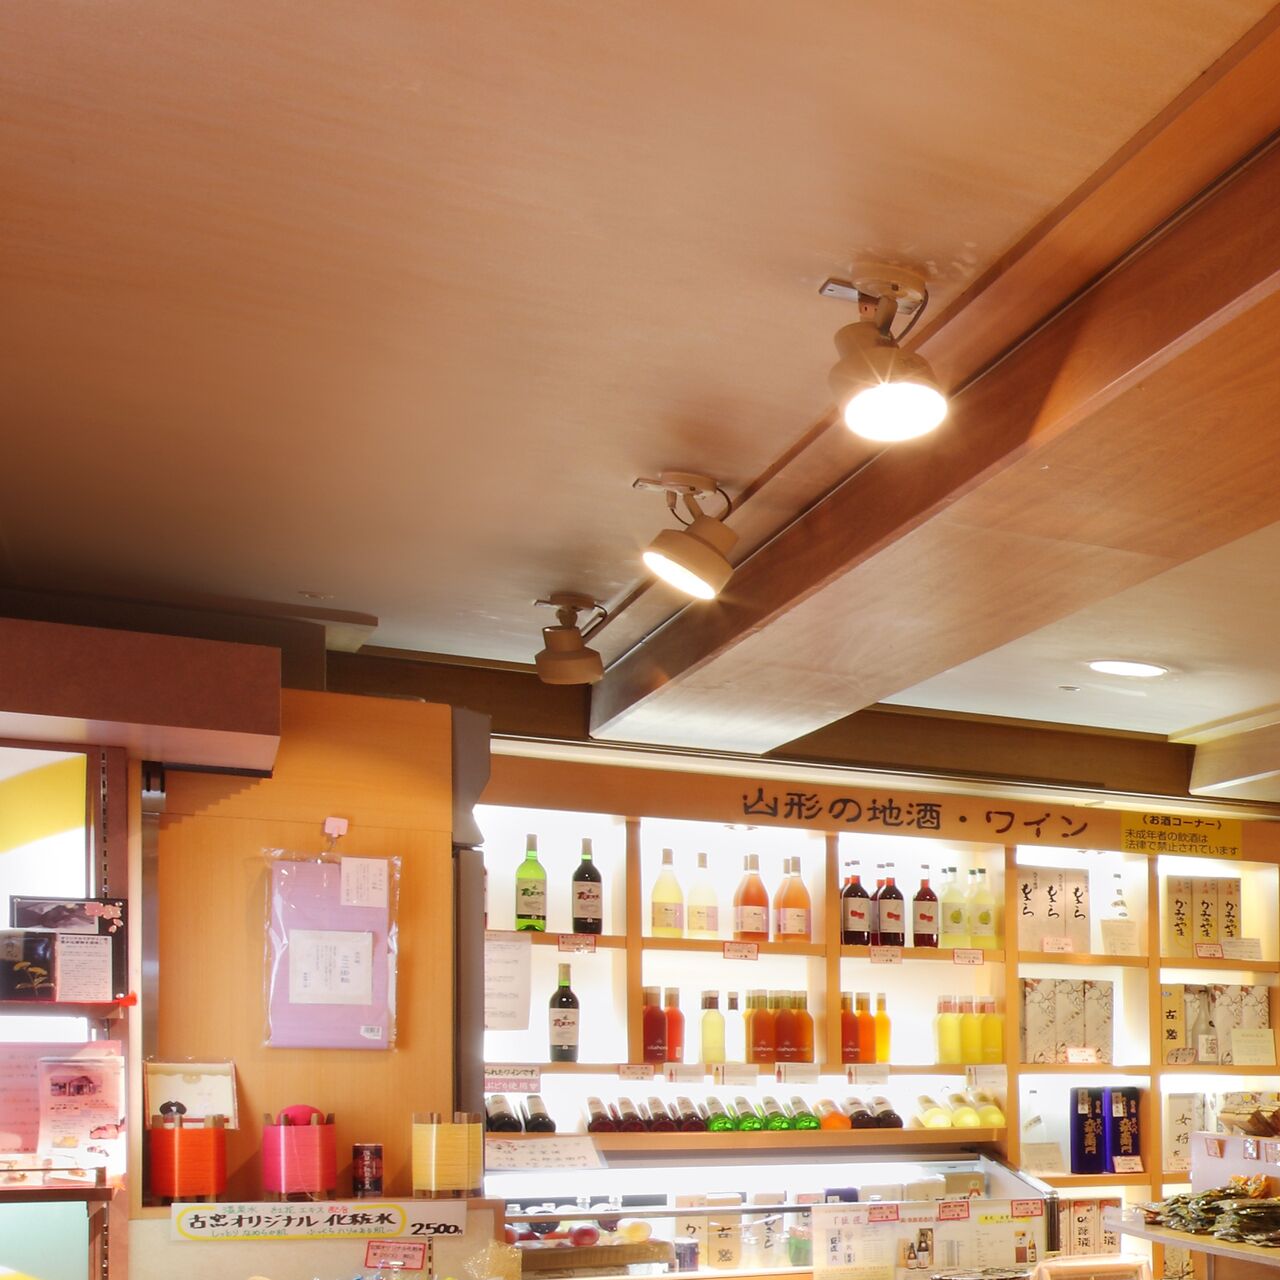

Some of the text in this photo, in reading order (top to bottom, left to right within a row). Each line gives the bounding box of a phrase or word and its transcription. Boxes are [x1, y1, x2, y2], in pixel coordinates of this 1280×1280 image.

[741, 787, 1088, 838] 山形の地酒・ワイン
[1125, 829, 1207, 842] 未成年者の飲酒は
[1124, 840, 1239, 855] 法律で禁止されています
